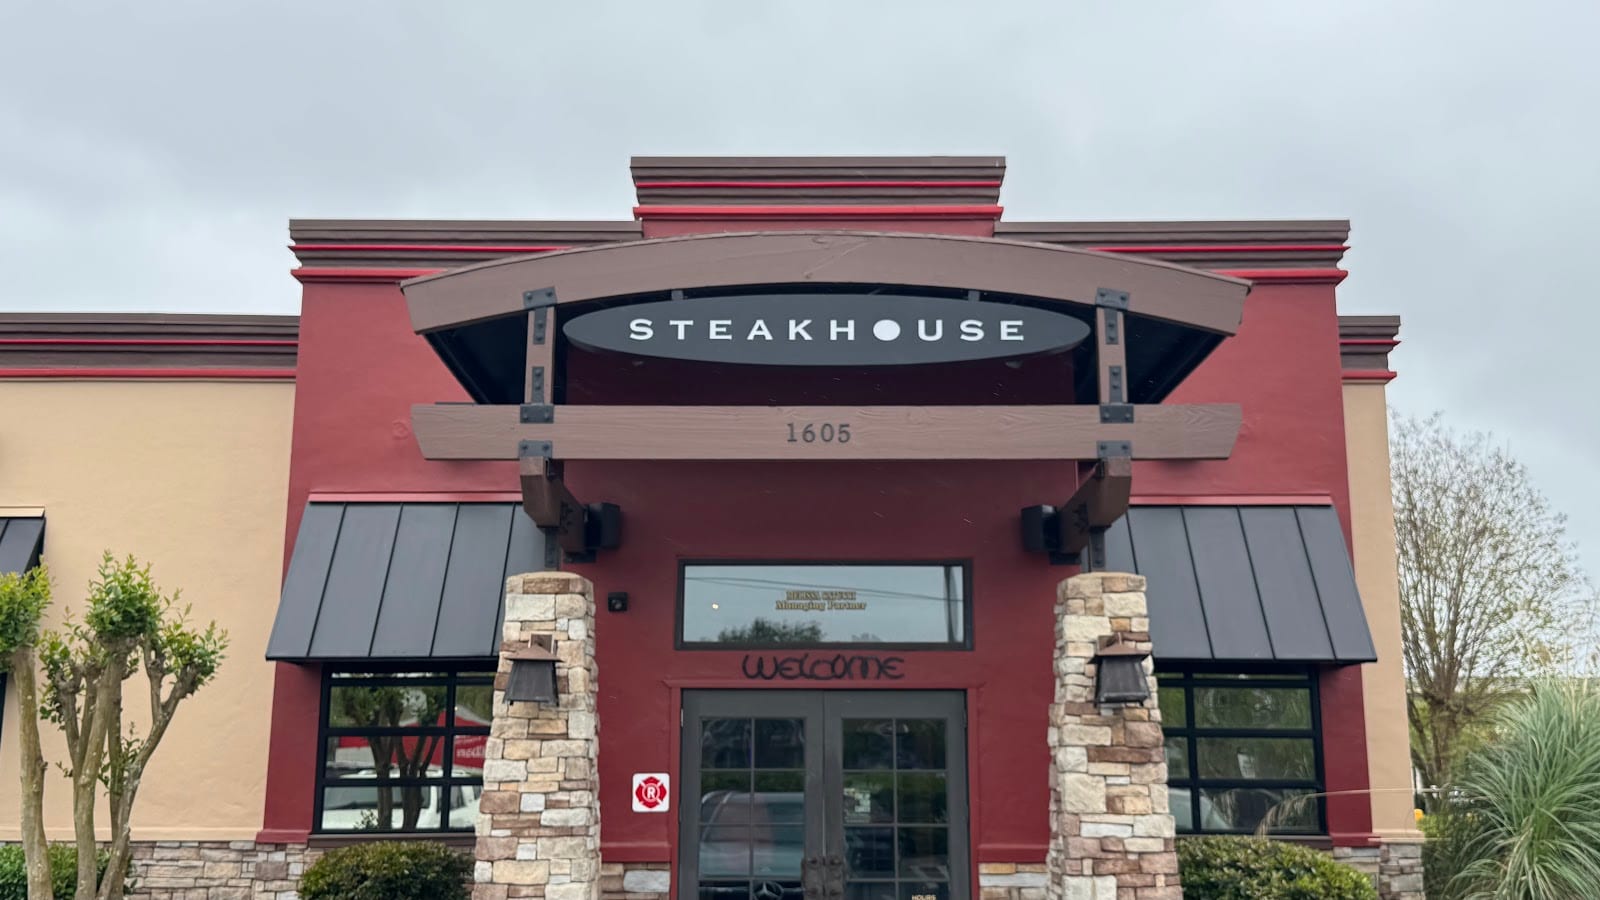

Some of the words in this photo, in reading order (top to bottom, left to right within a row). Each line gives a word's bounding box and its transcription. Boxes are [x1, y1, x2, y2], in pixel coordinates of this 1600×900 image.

[629, 318, 1025, 342] STEAKHOUSE
[786, 422, 851, 443] 1605
[775, 600, 825, 611] Managing
[827, 600, 867, 610] Partner
[646, 786, 656, 800] R
